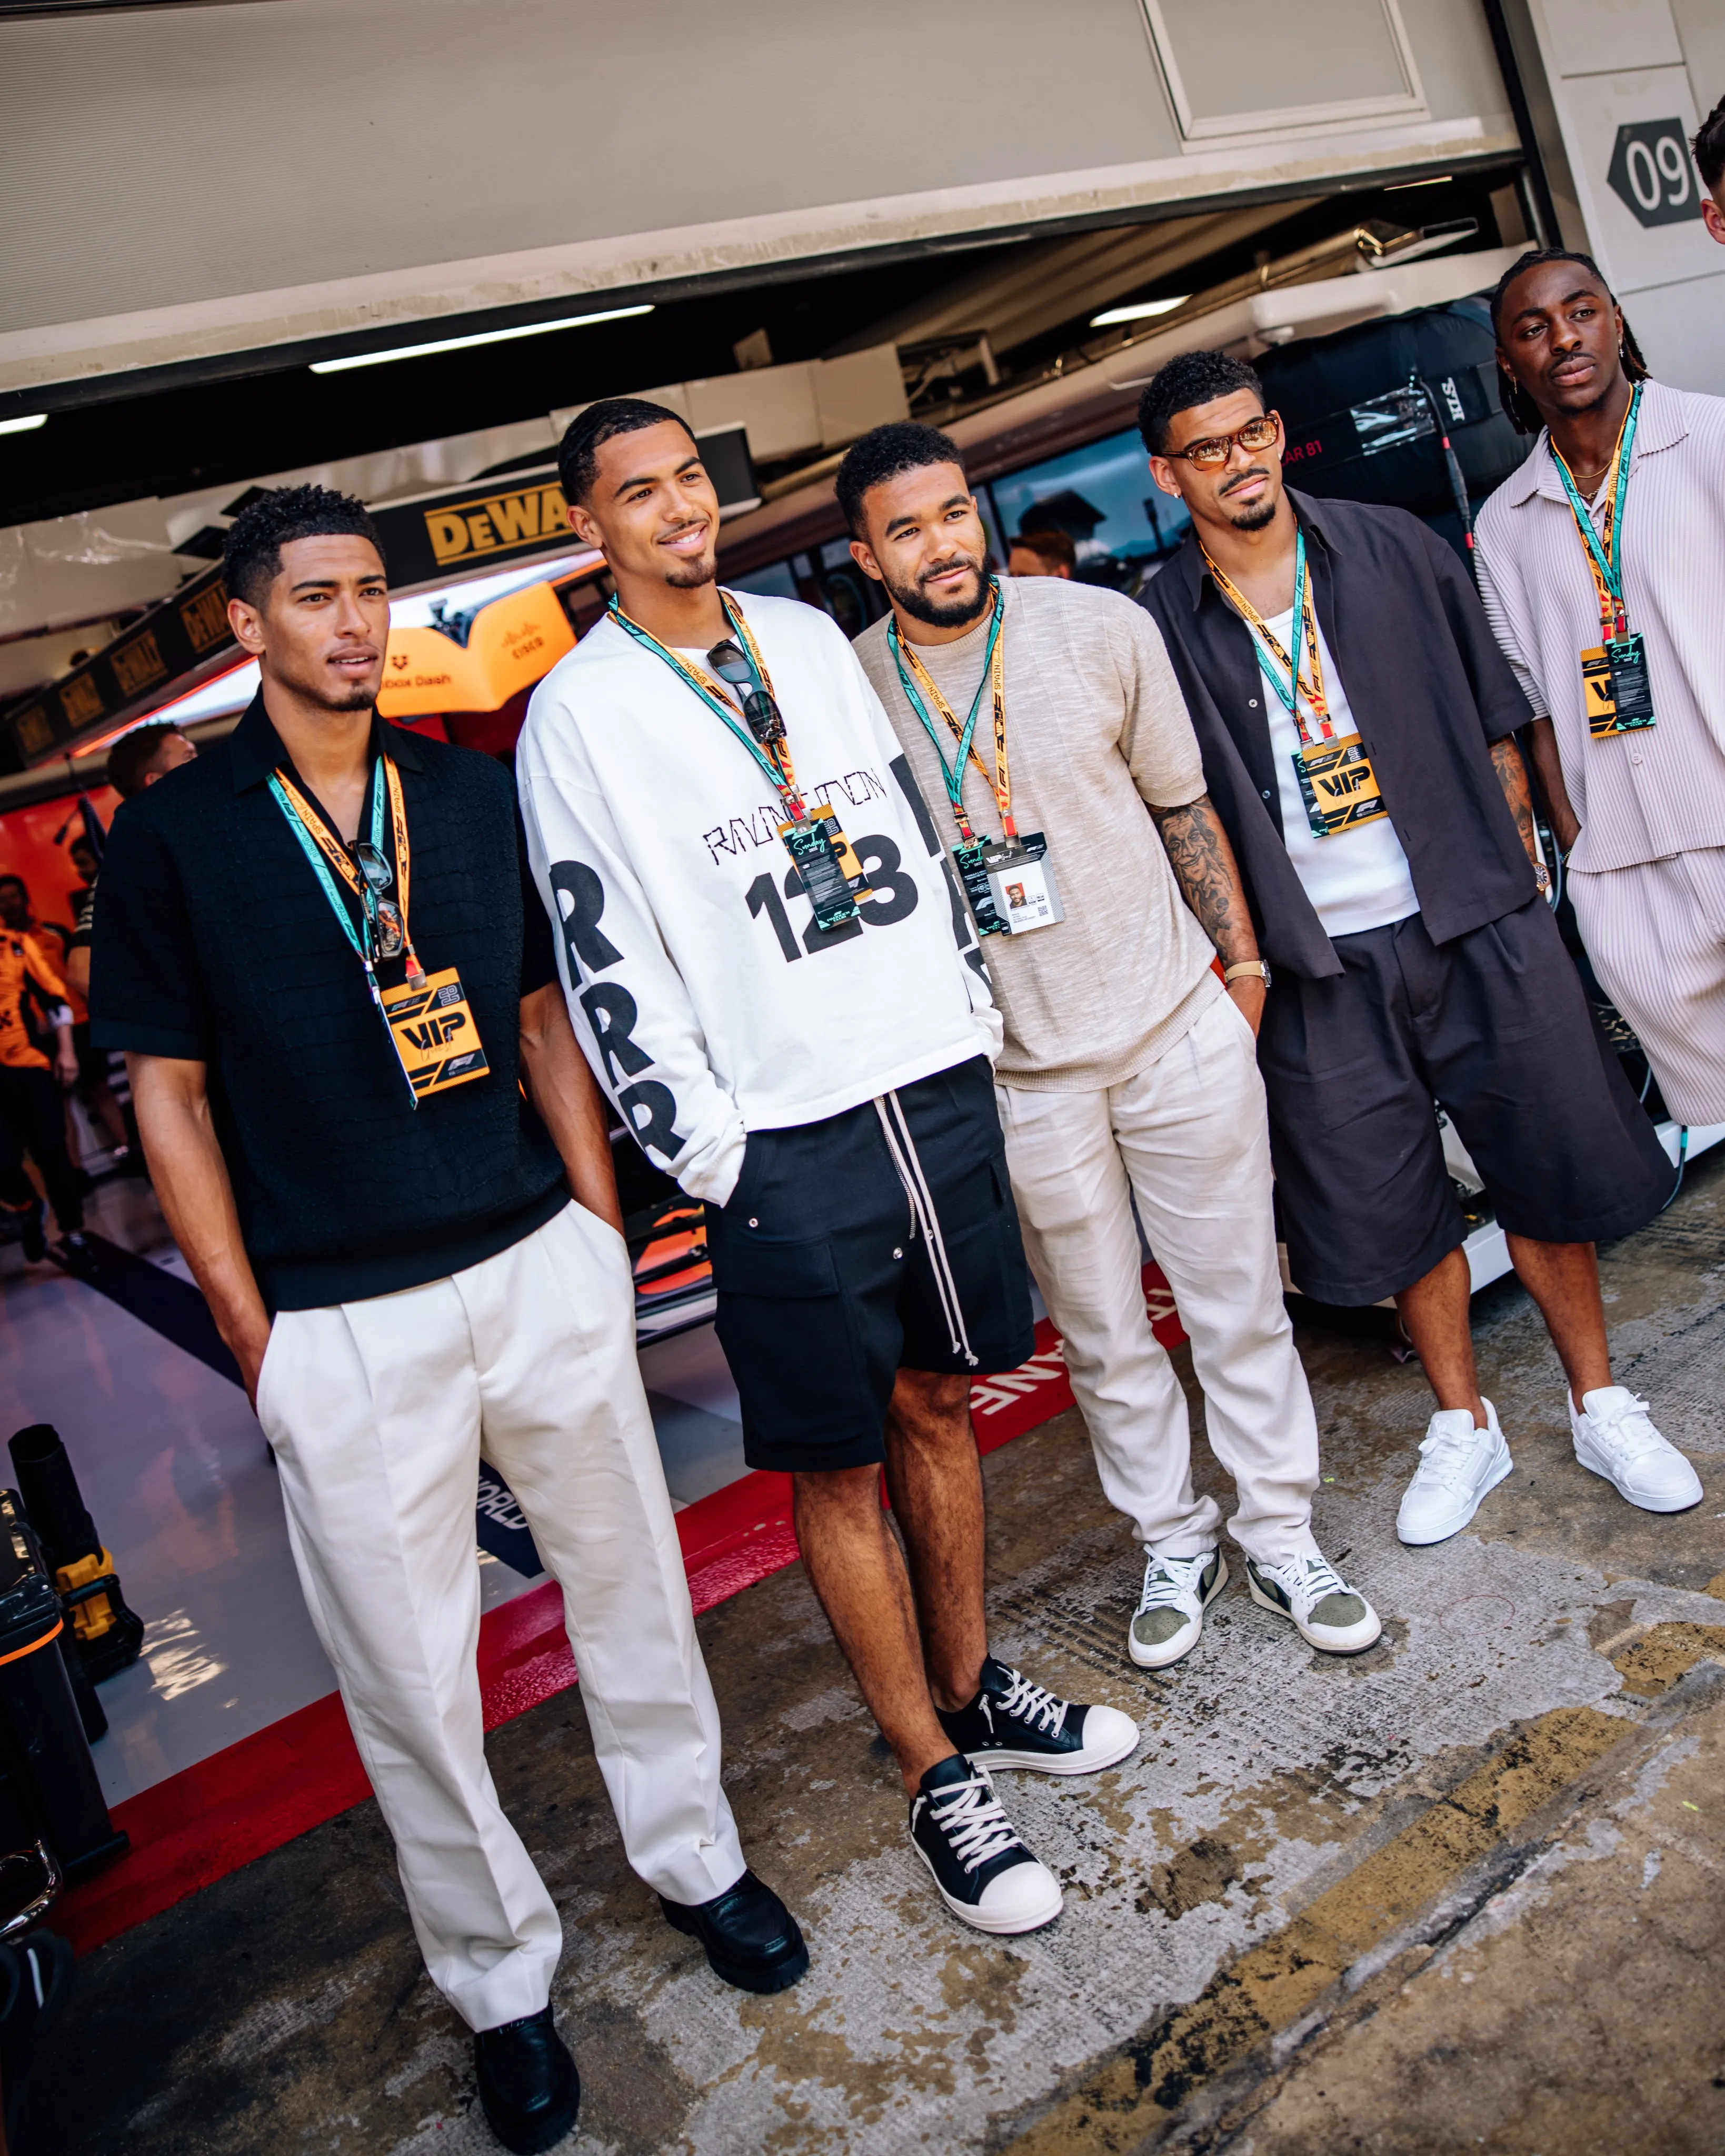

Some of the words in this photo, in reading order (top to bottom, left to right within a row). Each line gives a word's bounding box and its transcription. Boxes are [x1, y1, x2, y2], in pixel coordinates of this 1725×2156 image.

[1626, 136, 1689, 211] 09
[1282, 446, 1304, 467] AR
[1307, 440, 1322, 457] 81
[1609, 473, 1618, 497] SPAIN
[1617, 491, 1626, 513] SUNDAY
[1242, 602, 1260, 623] SPAIN
[751, 643, 763, 664] SPAIN
[1273, 643, 1285, 659] VIP
[1611, 645, 1641, 664] Sunday
[416, 674, 451, 687] Dash
[684, 662, 707, 684] SPAIN
[928, 686, 945, 709] SPAIN
[995, 721, 1004, 736] VIP
[1318, 766, 1370, 797] VIP
[1356, 800, 1378, 813] F1
[303, 809, 323, 835] SPAIN
[303, 834, 319, 857] SUNDAY
[793, 833, 826, 855] Sunday
[986, 854, 1002, 864] VIP
[744, 834, 918, 963] 123
[549, 860, 625, 992] R
[400, 1012, 466, 1050] VIP
[580, 982, 655, 1090] R
[447, 1053, 475, 1071] F1
[969, 1339, 1065, 1416] ANE
